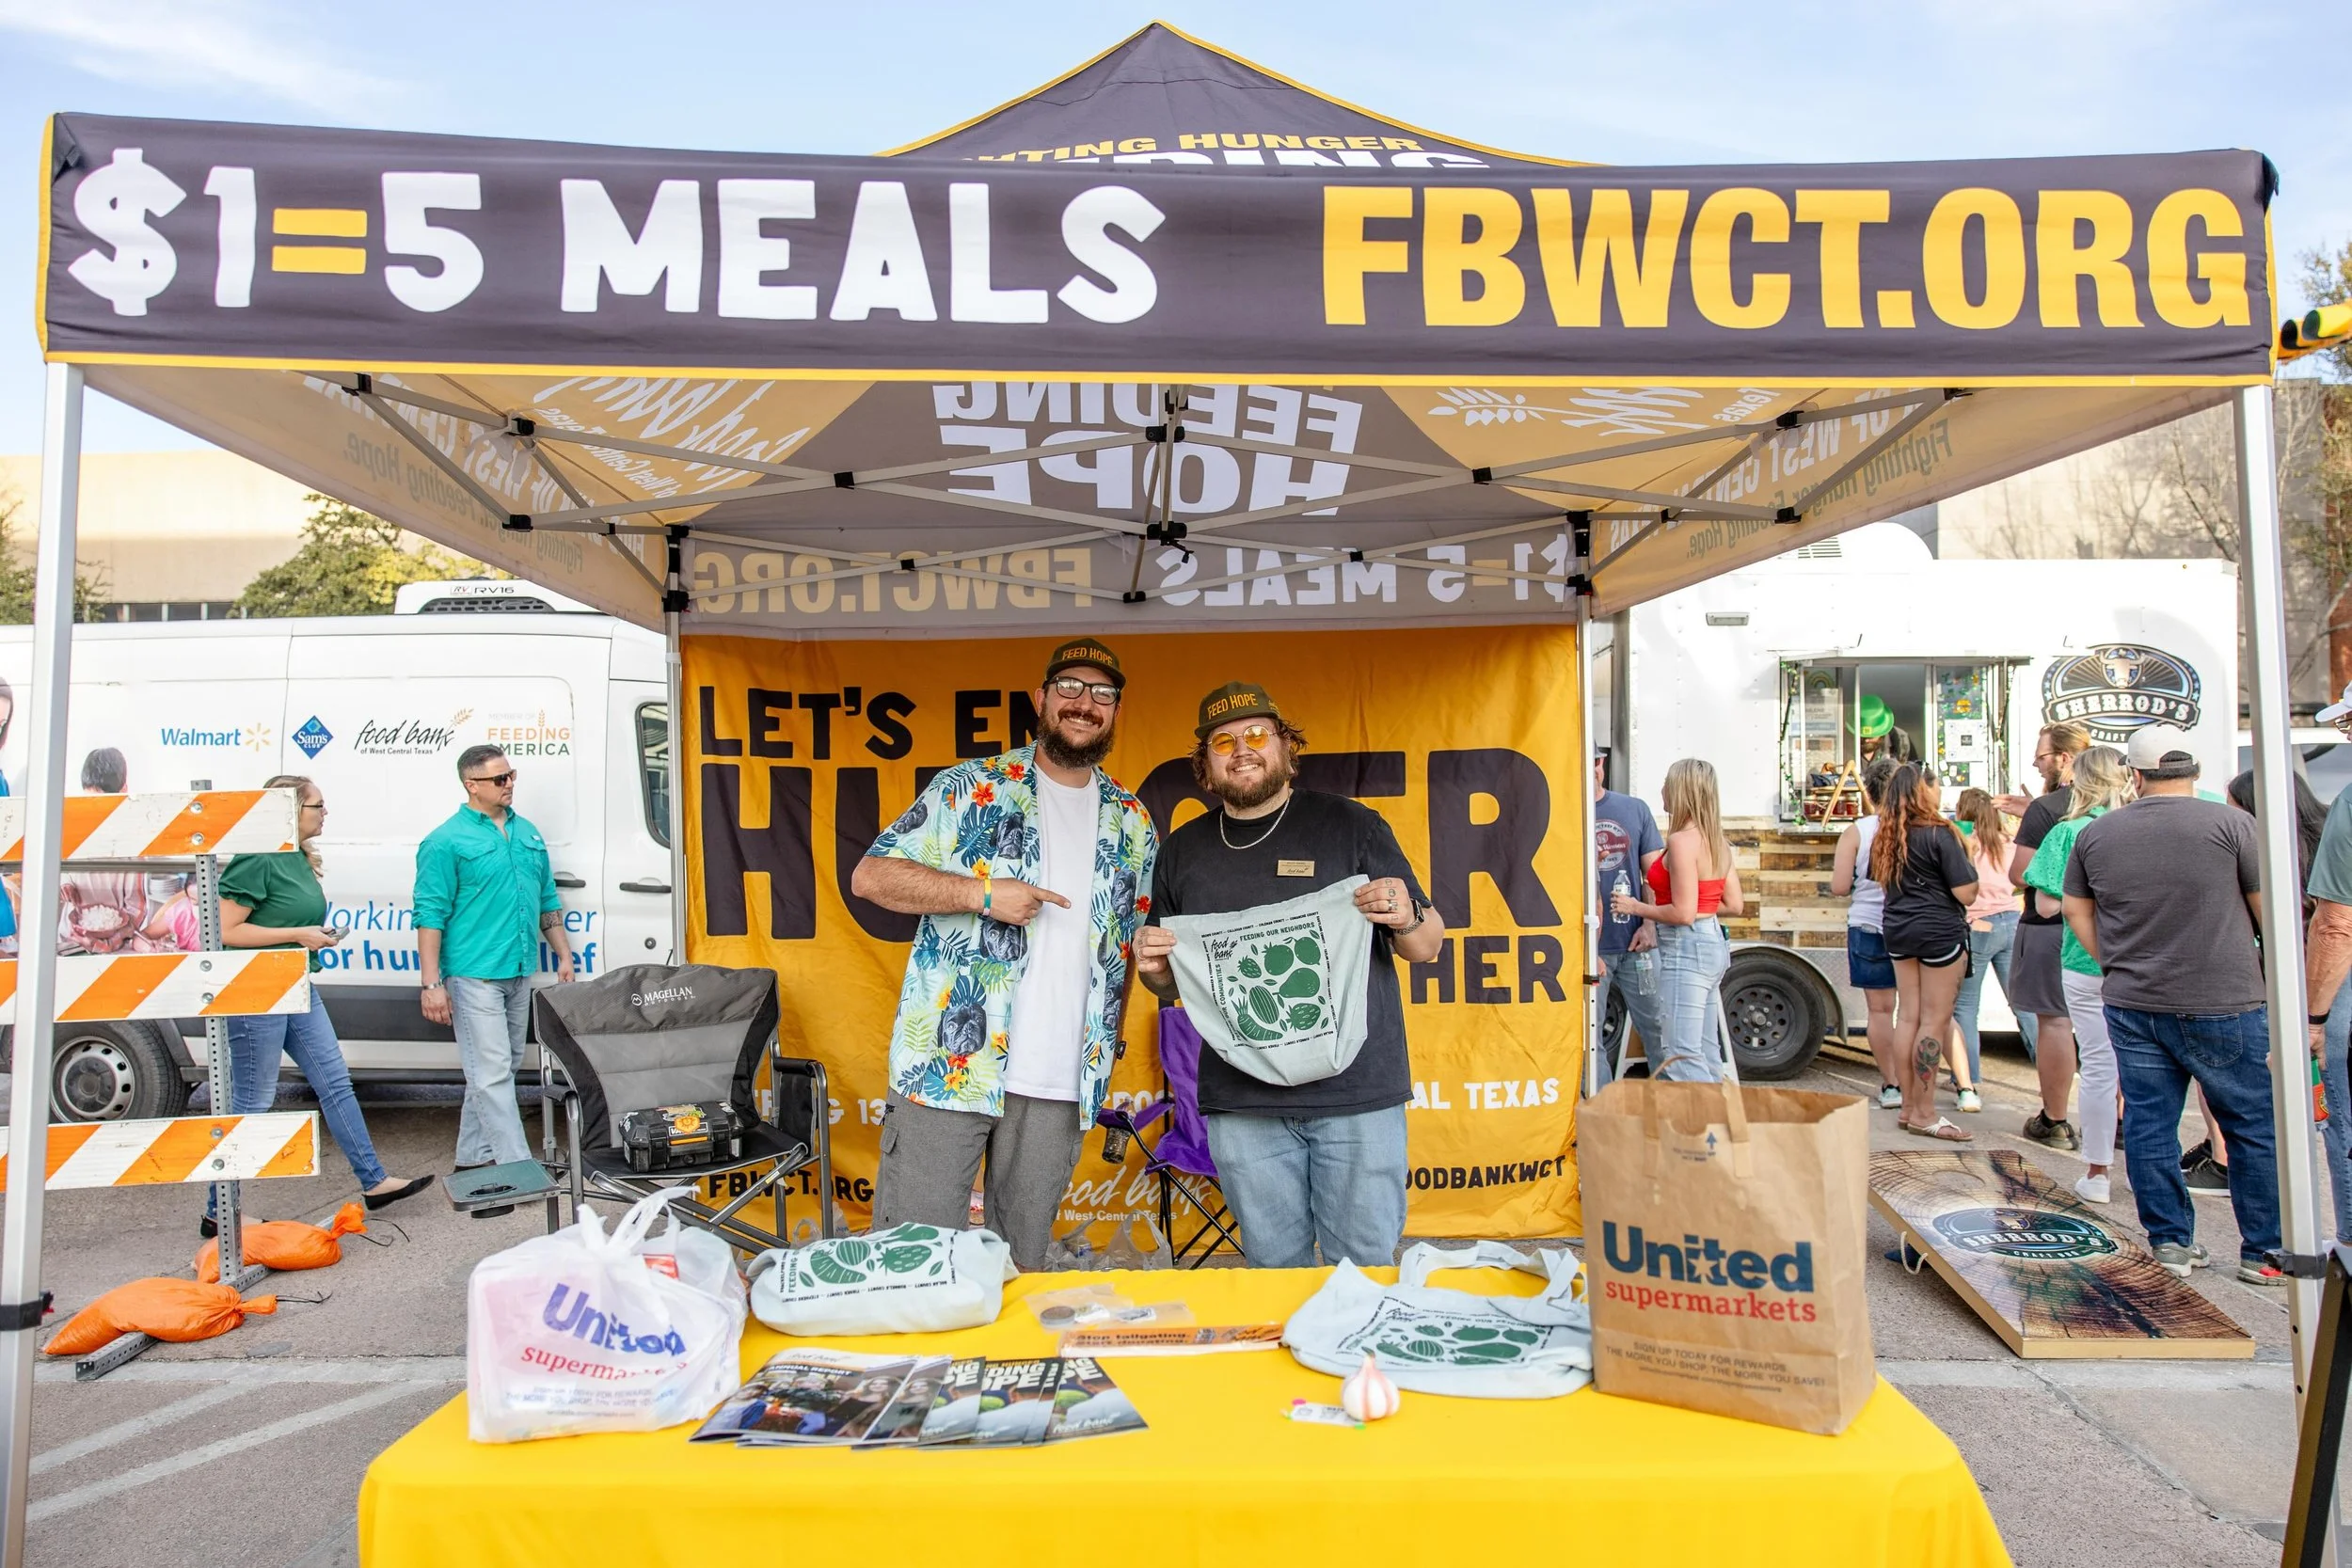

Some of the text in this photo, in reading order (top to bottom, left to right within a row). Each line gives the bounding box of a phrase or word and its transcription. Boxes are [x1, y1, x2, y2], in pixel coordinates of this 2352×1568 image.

[1178, 133, 1423, 152] HUNGER
[68, 148, 1166, 324] $1=5 MEALS
[1323, 186, 2250, 330] FBWCT.ORG
[1062, 647, 1114, 667] FEED HOPE
[1207, 698, 1229, 721] FEED
[1229, 693, 1259, 709] HOPE
[2056, 693, 2190, 721] SHERROD'S
[161, 728, 241, 746] Walmart
[355, 719, 455, 752] food bank
[487, 727, 571, 741] FEEDING
[699, 686, 1040, 761] LET'S EN
[2090, 728, 2126, 742] CRAFT
[296, 730, 328, 745] Sam's
[489, 743, 570, 755] MERICA
[325, 900, 414, 931] orkin
[1211, 937, 1230, 953] food
[1240, 922, 1315, 942] FEEDING OUR NEIGHBORS
[318, 944, 353, 971] or
[1215, 948, 1233, 959] bank
[644, 986, 693, 1004] MAGELLAN
[1215, 963, 1227, 1006] COMMUNITIES
[1464, 1078, 1560, 1110] TEXAS
[1061, 1165, 1128, 1207] ood
[1406, 1155, 1565, 1191] ODBANKWCT
[709, 1171, 875, 1203] FBWCT.RG
[1064, 1211, 1093, 1221] West
[1144, 1210, 1177, 1221] Tes
[1963, 1231, 2104, 1247] SHERROD'S
[1602, 1220, 1815, 1293] United
[2013, 1250, 2053, 1259] CRAFT
[788, 1258, 798, 1292] FEEDING
[1605, 1279, 1817, 1323] supermarkets
[1606, 1345, 1624, 1357] THE
[1626, 1351, 1653, 1364] MORE
[1655, 1356, 1677, 1368] YOU
[1711, 1367, 1733, 1378] THE
[1734, 1370, 1765, 1382] MORE
[1768, 1374, 1791, 1385] YOU
[1633, 1341, 1656, 1354] SIGN
[1658, 1346, 1673, 1355] UP
[1675, 1349, 1708, 1361] TODAY
[1710, 1354, 1732, 1365] FOR
[810, 1366, 852, 1375] REPORT
